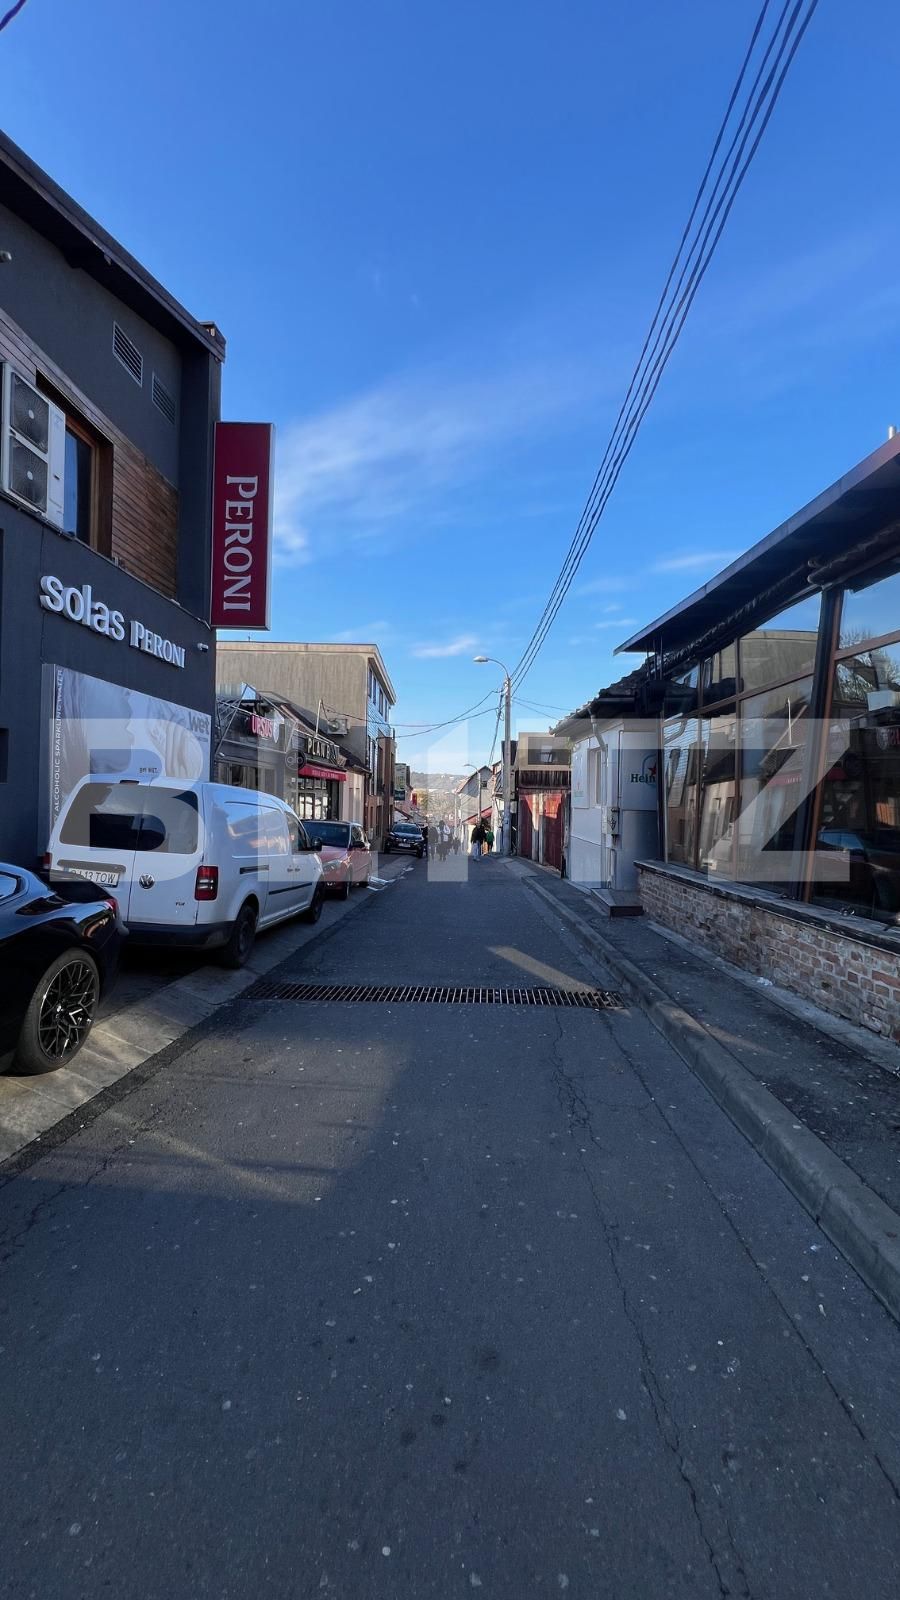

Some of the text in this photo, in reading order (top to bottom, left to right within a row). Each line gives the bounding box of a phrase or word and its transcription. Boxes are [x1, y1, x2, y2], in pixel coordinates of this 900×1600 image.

[223, 475, 258, 611] PERONI
[129, 620, 186, 668] PERONI
[252, 714, 273, 738] URSUS
[631, 773, 657, 783] Hein
[95, 871, 116, 884] TOW
